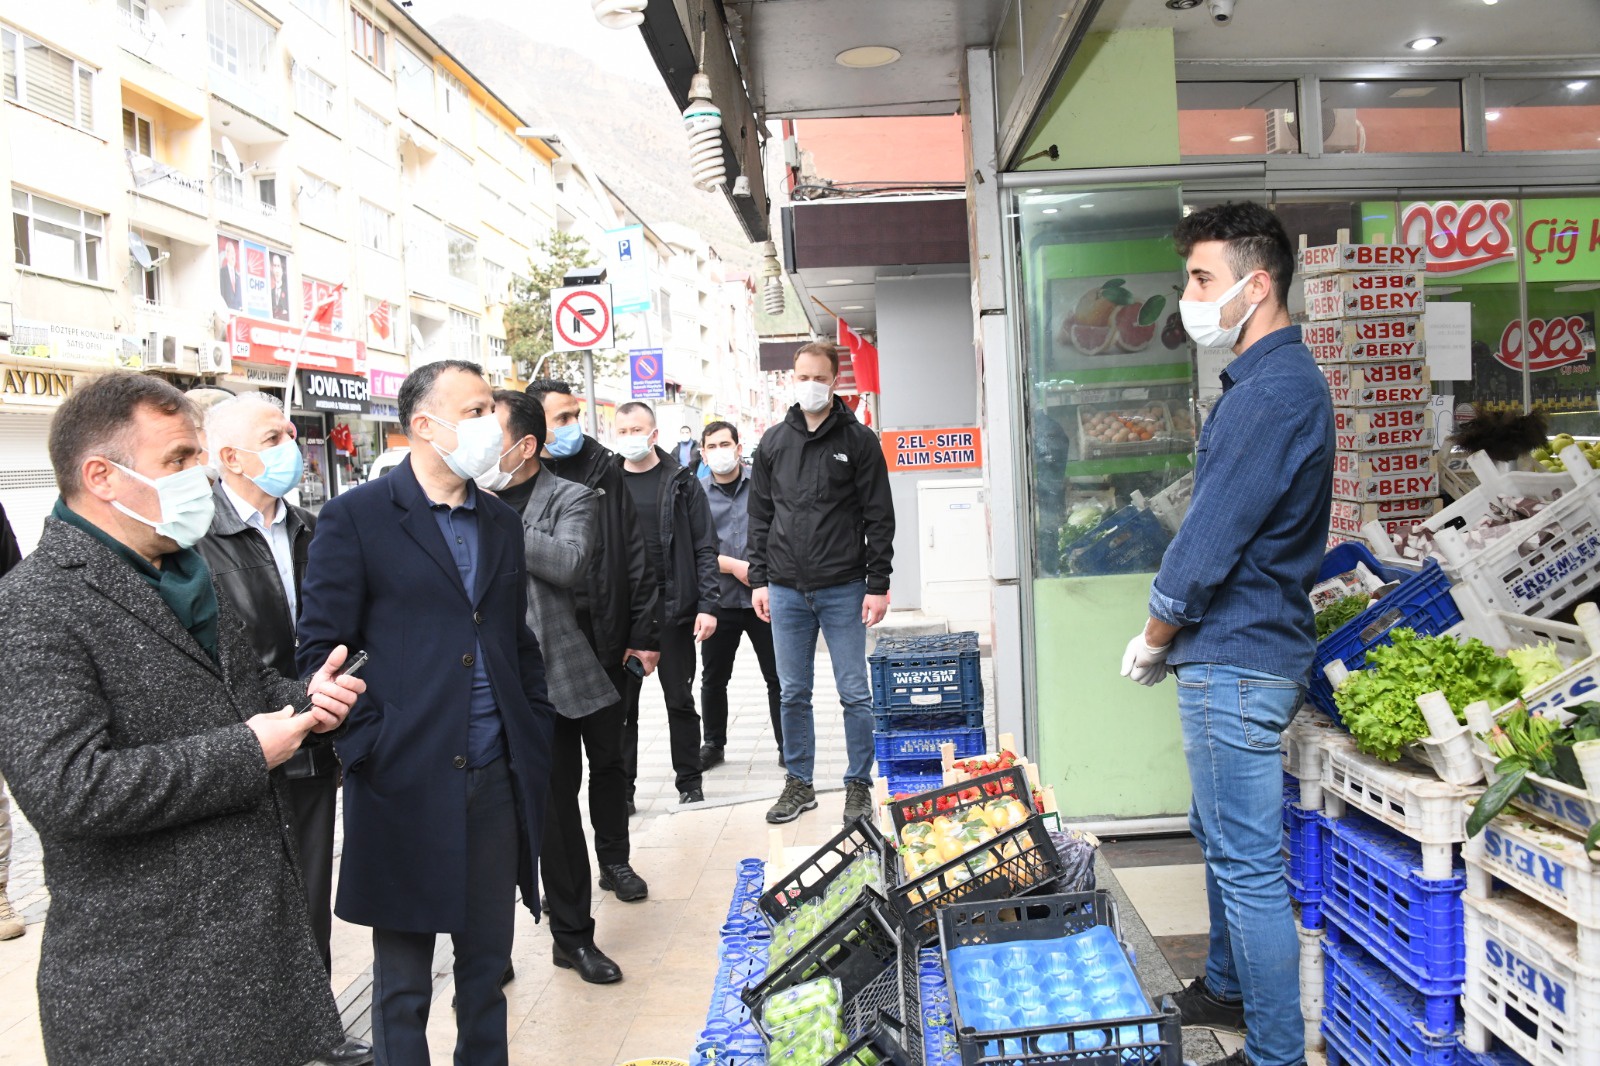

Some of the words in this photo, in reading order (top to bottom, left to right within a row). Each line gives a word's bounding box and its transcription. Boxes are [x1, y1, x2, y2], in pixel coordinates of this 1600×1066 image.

[1526, 218, 1579, 264] Çiğ
[1305, 247, 1338, 265] BERY
[1358, 247, 1421, 264] BERY
[249, 278, 264, 290] CHP
[1307, 280, 1333, 295] BERY
[1314, 297, 1340, 314] BERY
[1361, 292, 1419, 310] BERY
[1305, 327, 1334, 344] BERY
[237, 344, 249, 353] CHP
[1315, 345, 1343, 358] BERY
[1367, 342, 1414, 356] BERY
[1324, 370, 1341, 386] BE
[307, 374, 340, 397] JOVA
[340, 379, 370, 401] TECH
[1376, 388, 1423, 401] BERY
[1370, 410, 1412, 428] BER
[897, 436, 926, 448] 2.EL
[937, 433, 972, 447] SIFIR
[1338, 435, 1355, 449] RY
[1379, 429, 1423, 444] BERY
[897, 452, 930, 465] ALIM
[934, 449, 974, 463] SATIM
[1333, 478, 1359, 497] ERY
[1380, 476, 1433, 495] BERY
[1331, 502, 1352, 518] BE
[1379, 499, 1420, 513] BER
[1331, 516, 1362, 532] BERY
[1513, 536, 1600, 598] ERDEMLER
[901, 743, 957, 753] DEMLER
